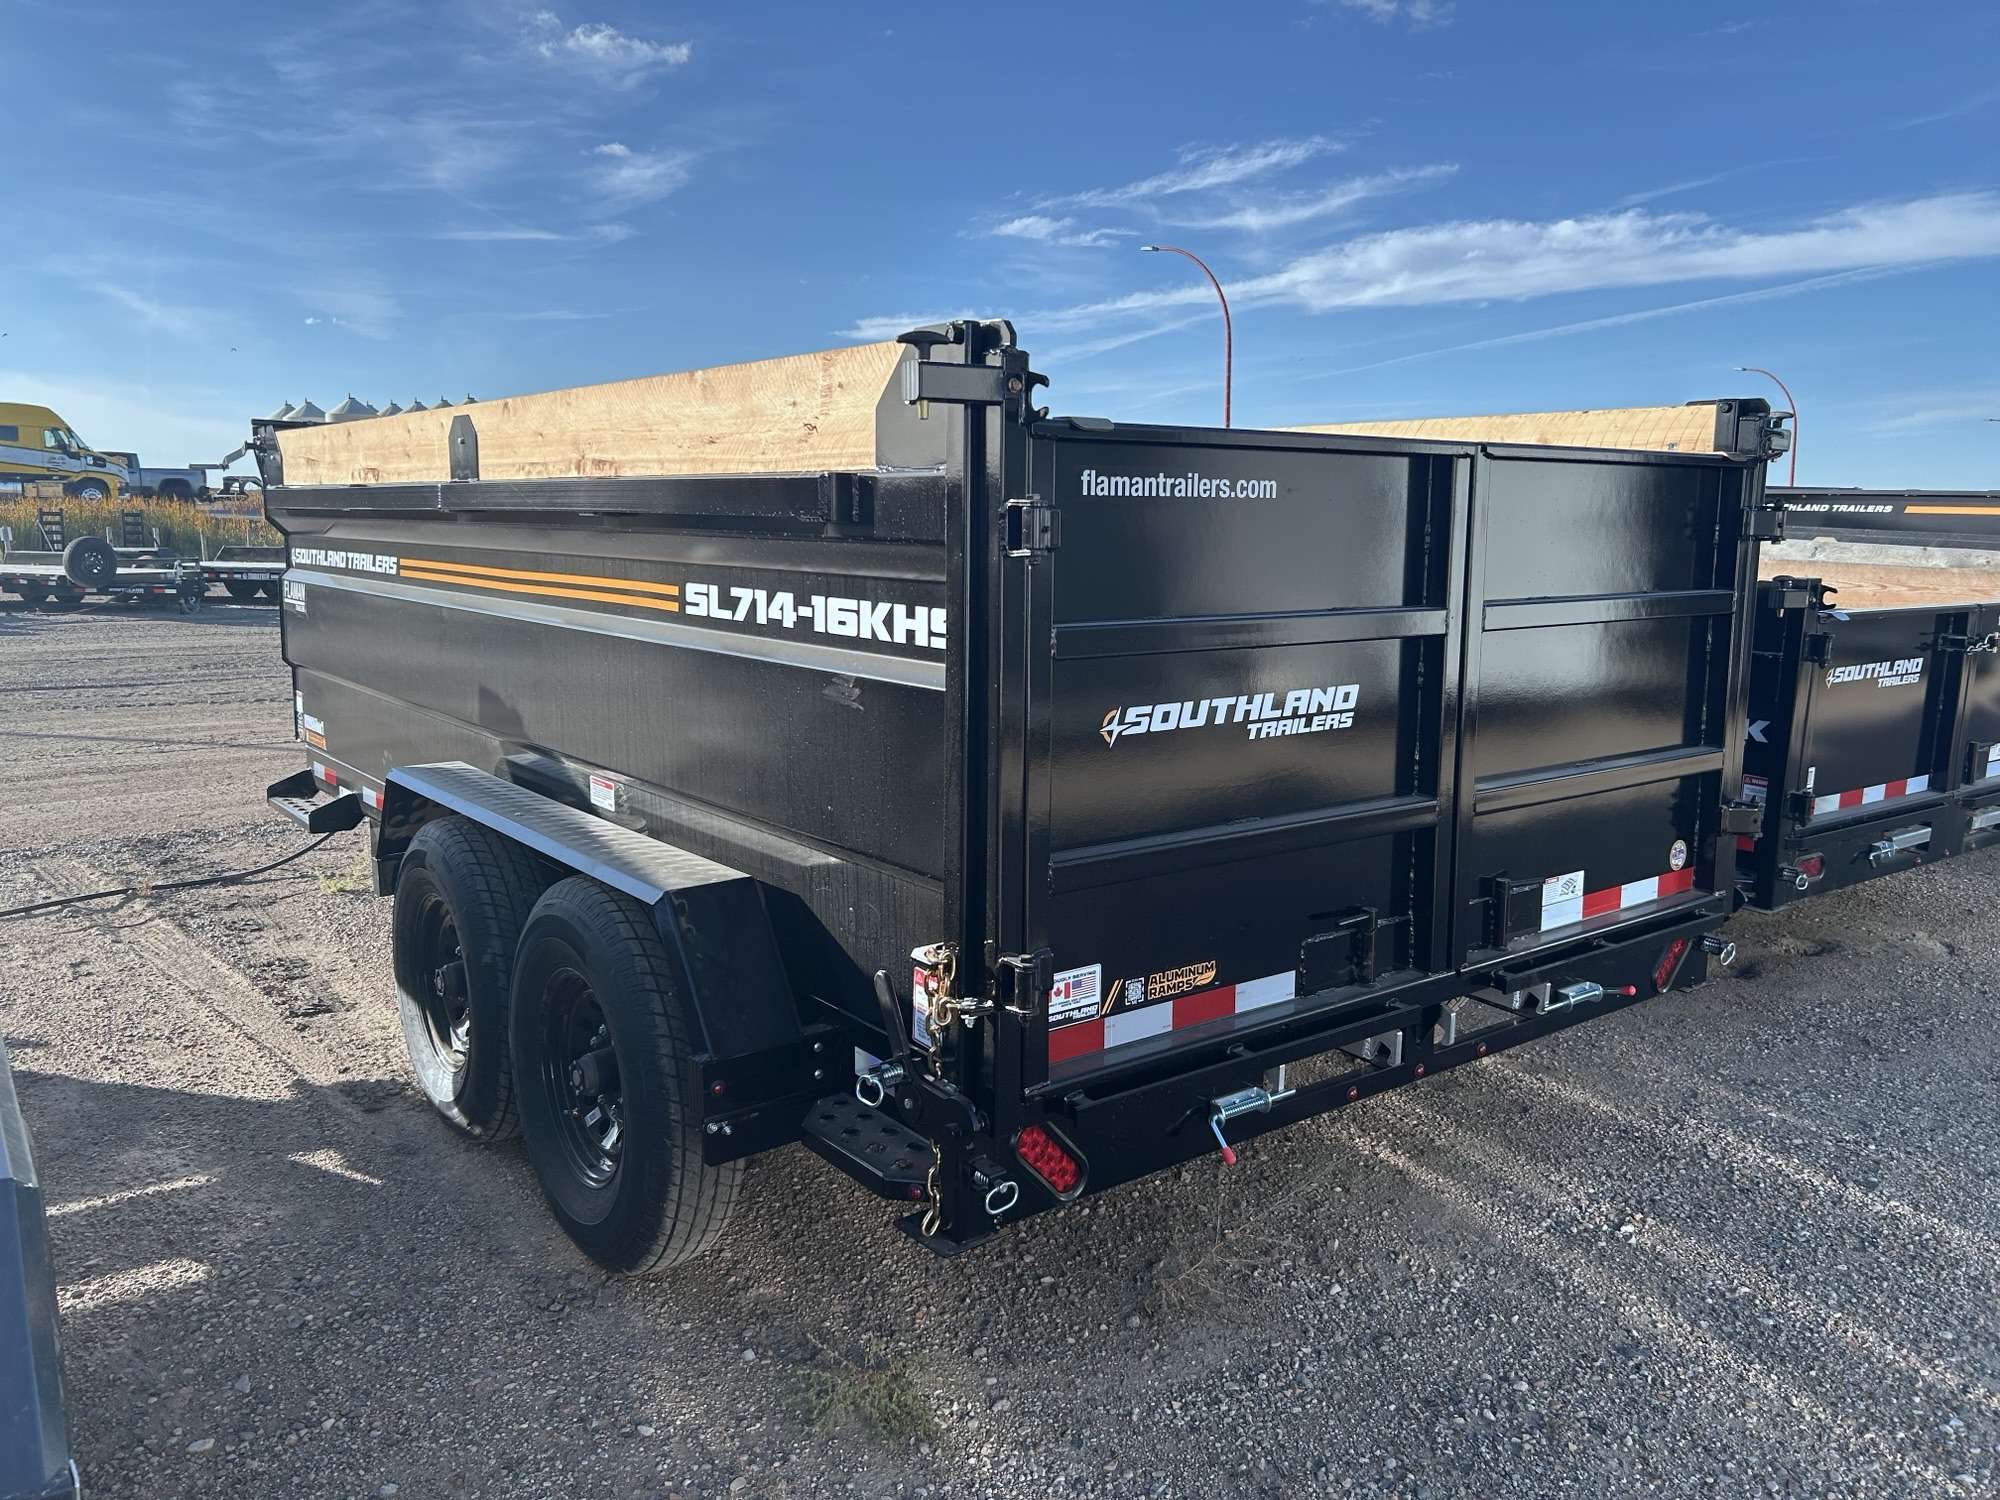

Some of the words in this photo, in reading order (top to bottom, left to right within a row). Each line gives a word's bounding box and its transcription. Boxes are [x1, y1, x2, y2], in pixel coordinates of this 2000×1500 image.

[1081, 469, 1277, 499] flamantrailers.com
[1764, 503, 1829, 512] THLAND
[1831, 504, 1894, 513] TRAILERS
[295, 548, 346, 568] SOUTHLAND
[347, 551, 398, 575] TRAILERS
[1833, 657, 1924, 684] SOUTHLAND
[1877, 673, 1920, 688] TRAILERS
[1121, 684, 1360, 736] SOUTHLAND
[1247, 712, 1354, 740] TRAILERS
[1149, 960, 1216, 987] ALUMINUM
[1148, 978, 1193, 1000] RAMPS
